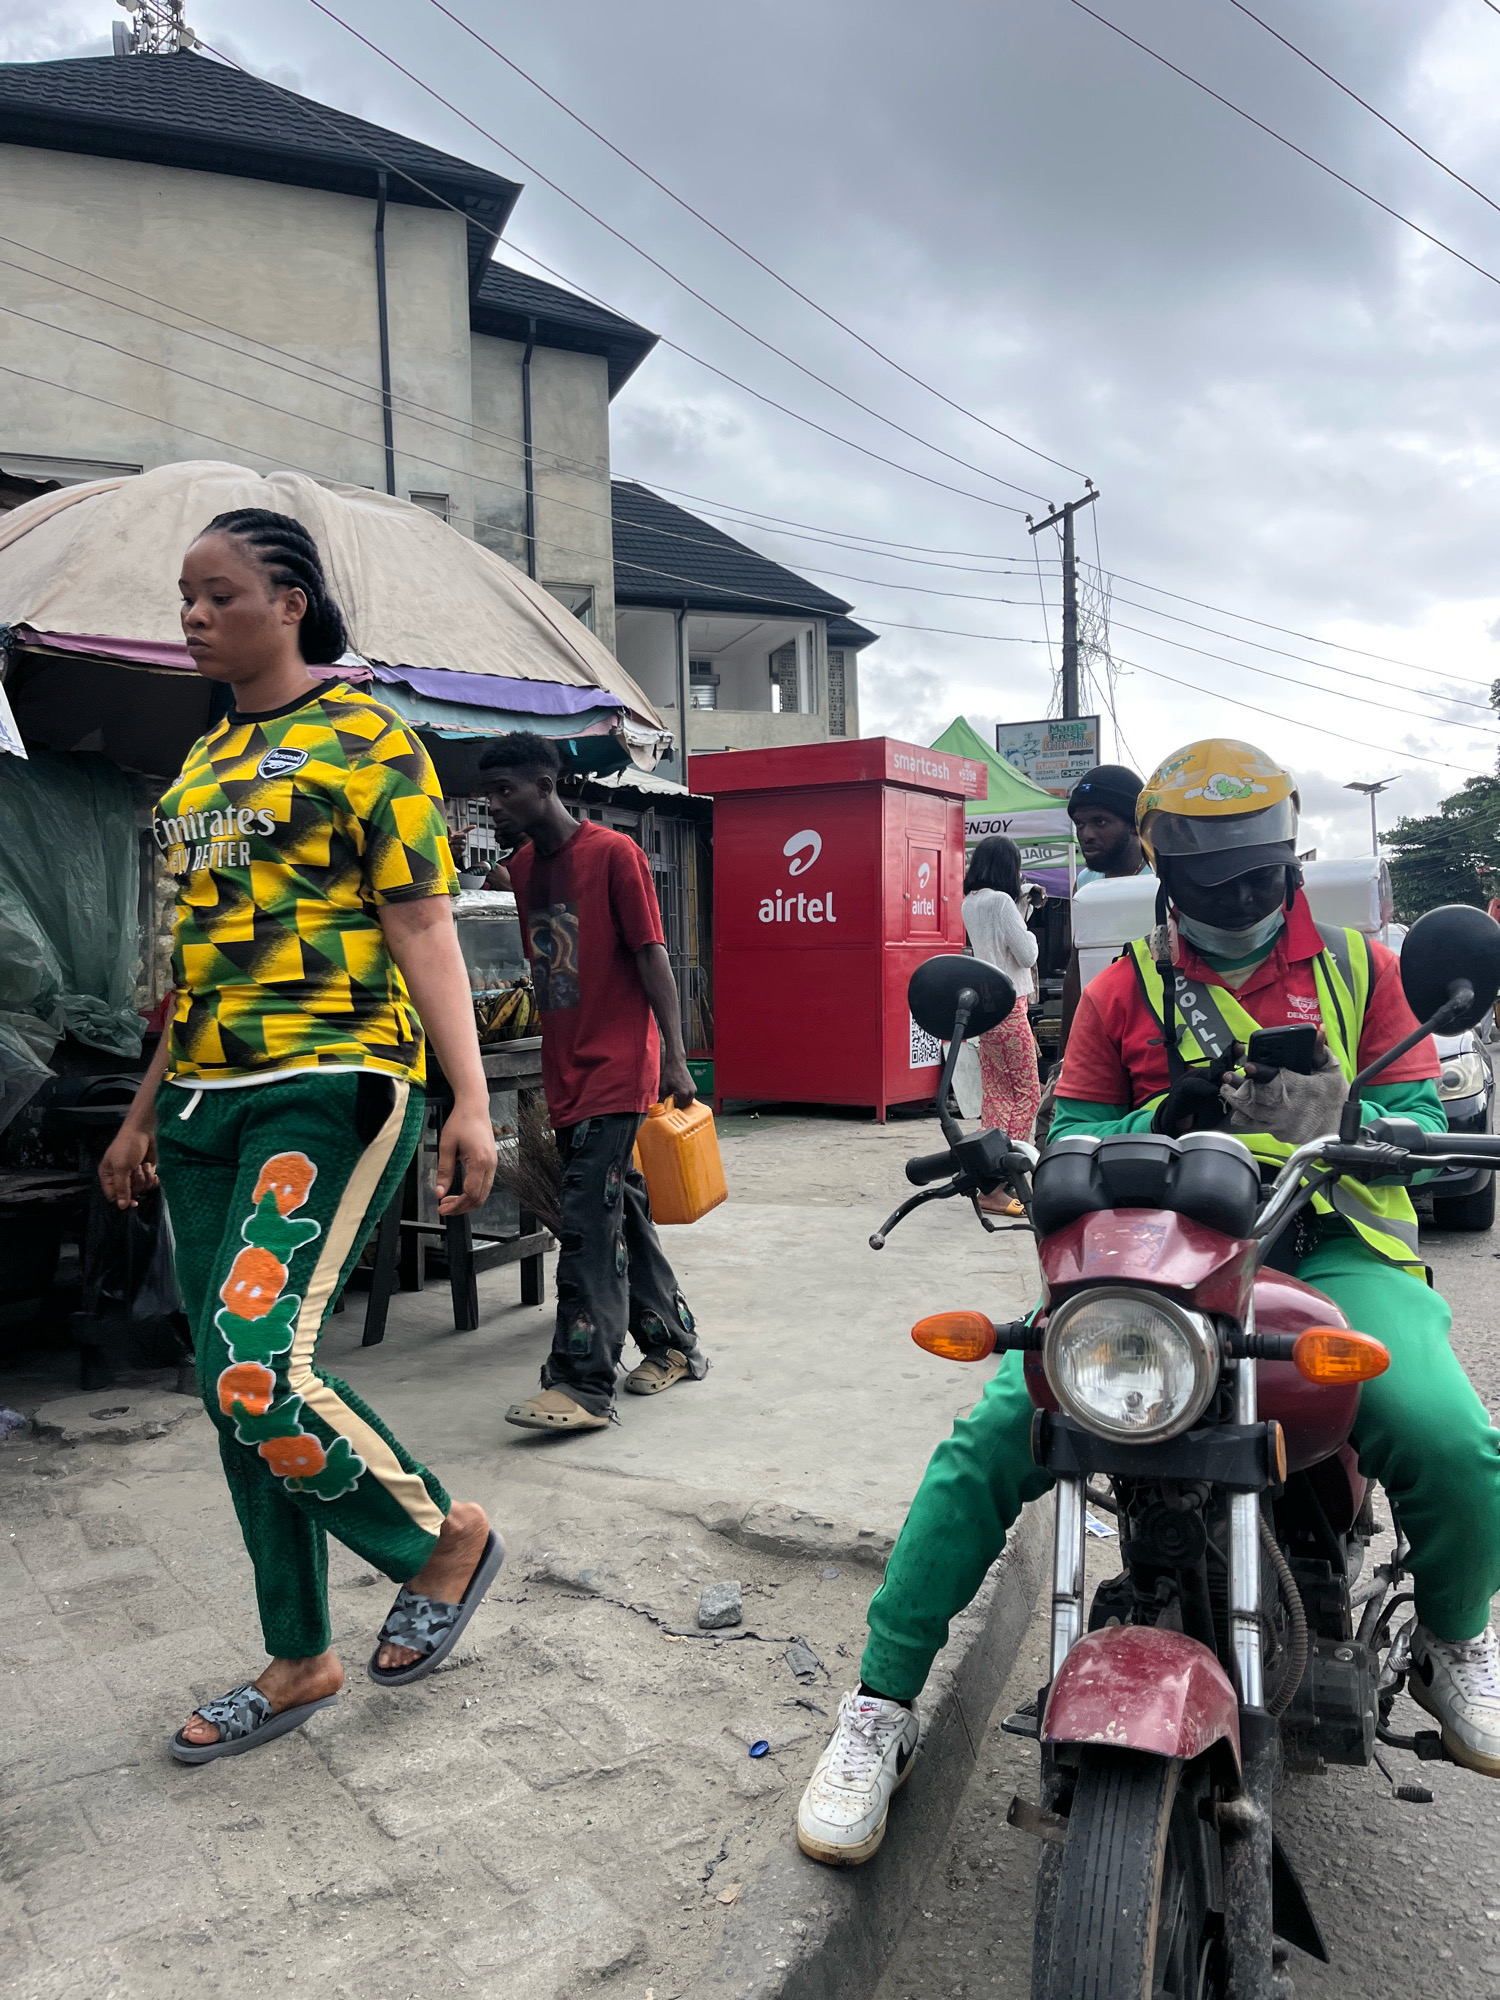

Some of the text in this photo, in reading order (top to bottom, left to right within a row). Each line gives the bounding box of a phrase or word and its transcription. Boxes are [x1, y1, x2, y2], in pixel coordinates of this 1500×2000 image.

[1047, 722, 1087, 733] Mama
[1051, 731, 1085, 741] Fresh
[1044, 739, 1091, 750] FROZEN FOODS
[270, 752, 301, 762] Arsenal
[893, 753, 950, 780] smartcash
[1071, 760, 1089, 768] FISH
[153, 804, 276, 850] Emirates
[965, 819, 1013, 835] ENJOY
[191, 841, 251, 872] BETTER
[758, 888, 837, 923] airtel
[912, 894, 935, 916] airtel
[1175, 975, 1223, 1058] COALI
